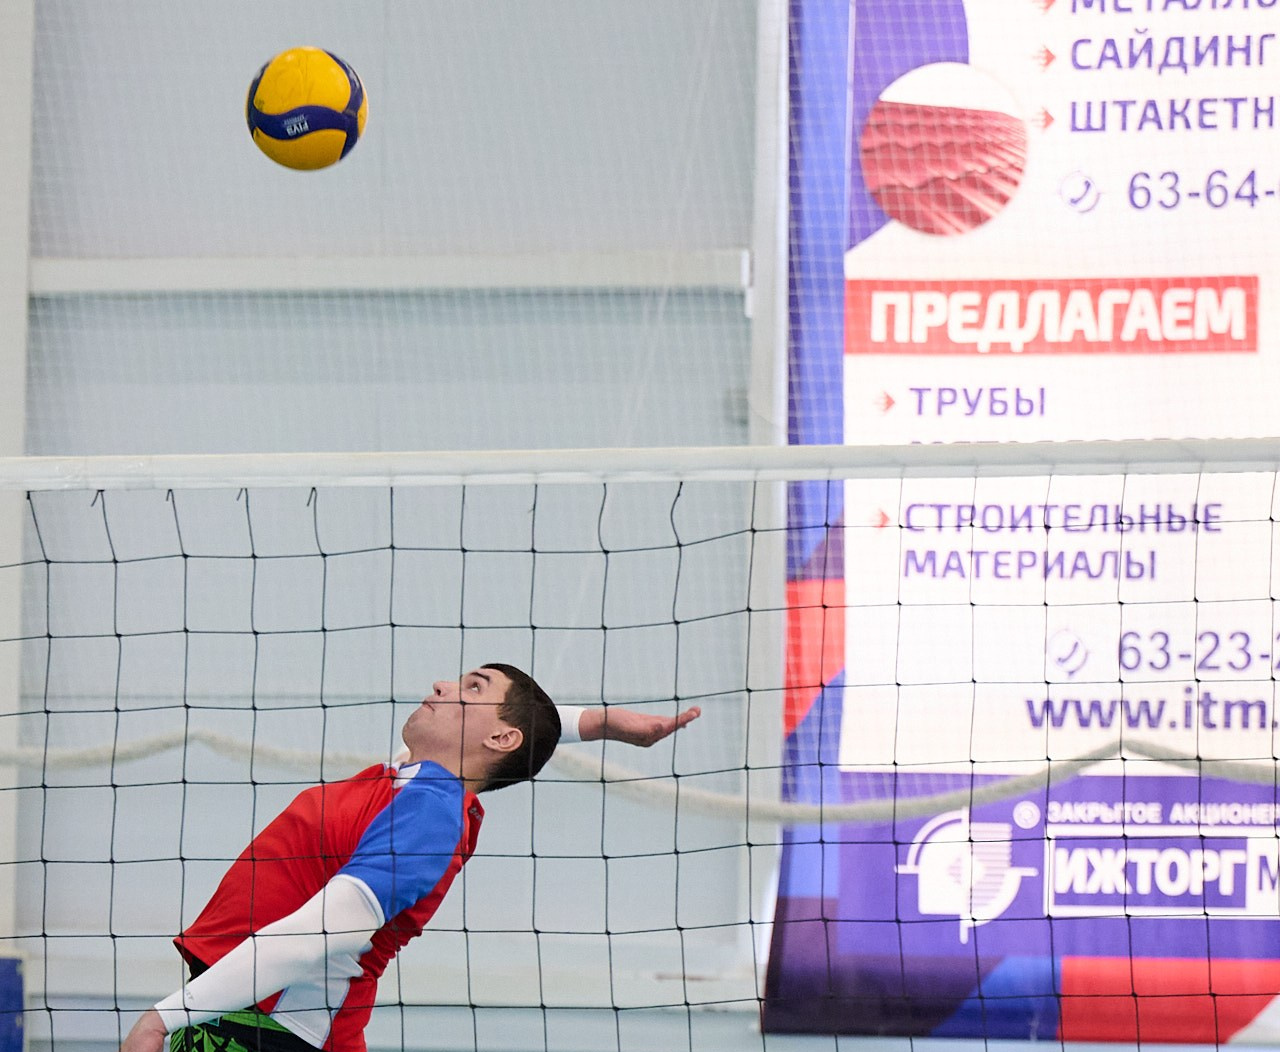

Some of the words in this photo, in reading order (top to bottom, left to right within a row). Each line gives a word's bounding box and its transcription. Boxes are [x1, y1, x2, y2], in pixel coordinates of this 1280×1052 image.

[1071, 27, 1276, 75] САЙДИНГ
[1070, 96, 1274, 132] ШТАКЕТН
[870, 287, 1246, 353] ПРЕДЛАГАЕМ
[909, 387, 1047, 416] ТРУБЫ
[905, 503, 1223, 533] СТРОИТЕЛЬНЫЕ
[904, 550, 1156, 580] МАТЕРИАЛЫ
[1120, 631, 1280, 670] 63-23-
[1047, 801, 1163, 824] ЗАКРЫТОЕ
[1169, 802, 1280, 826] АКЦИОНЕ
